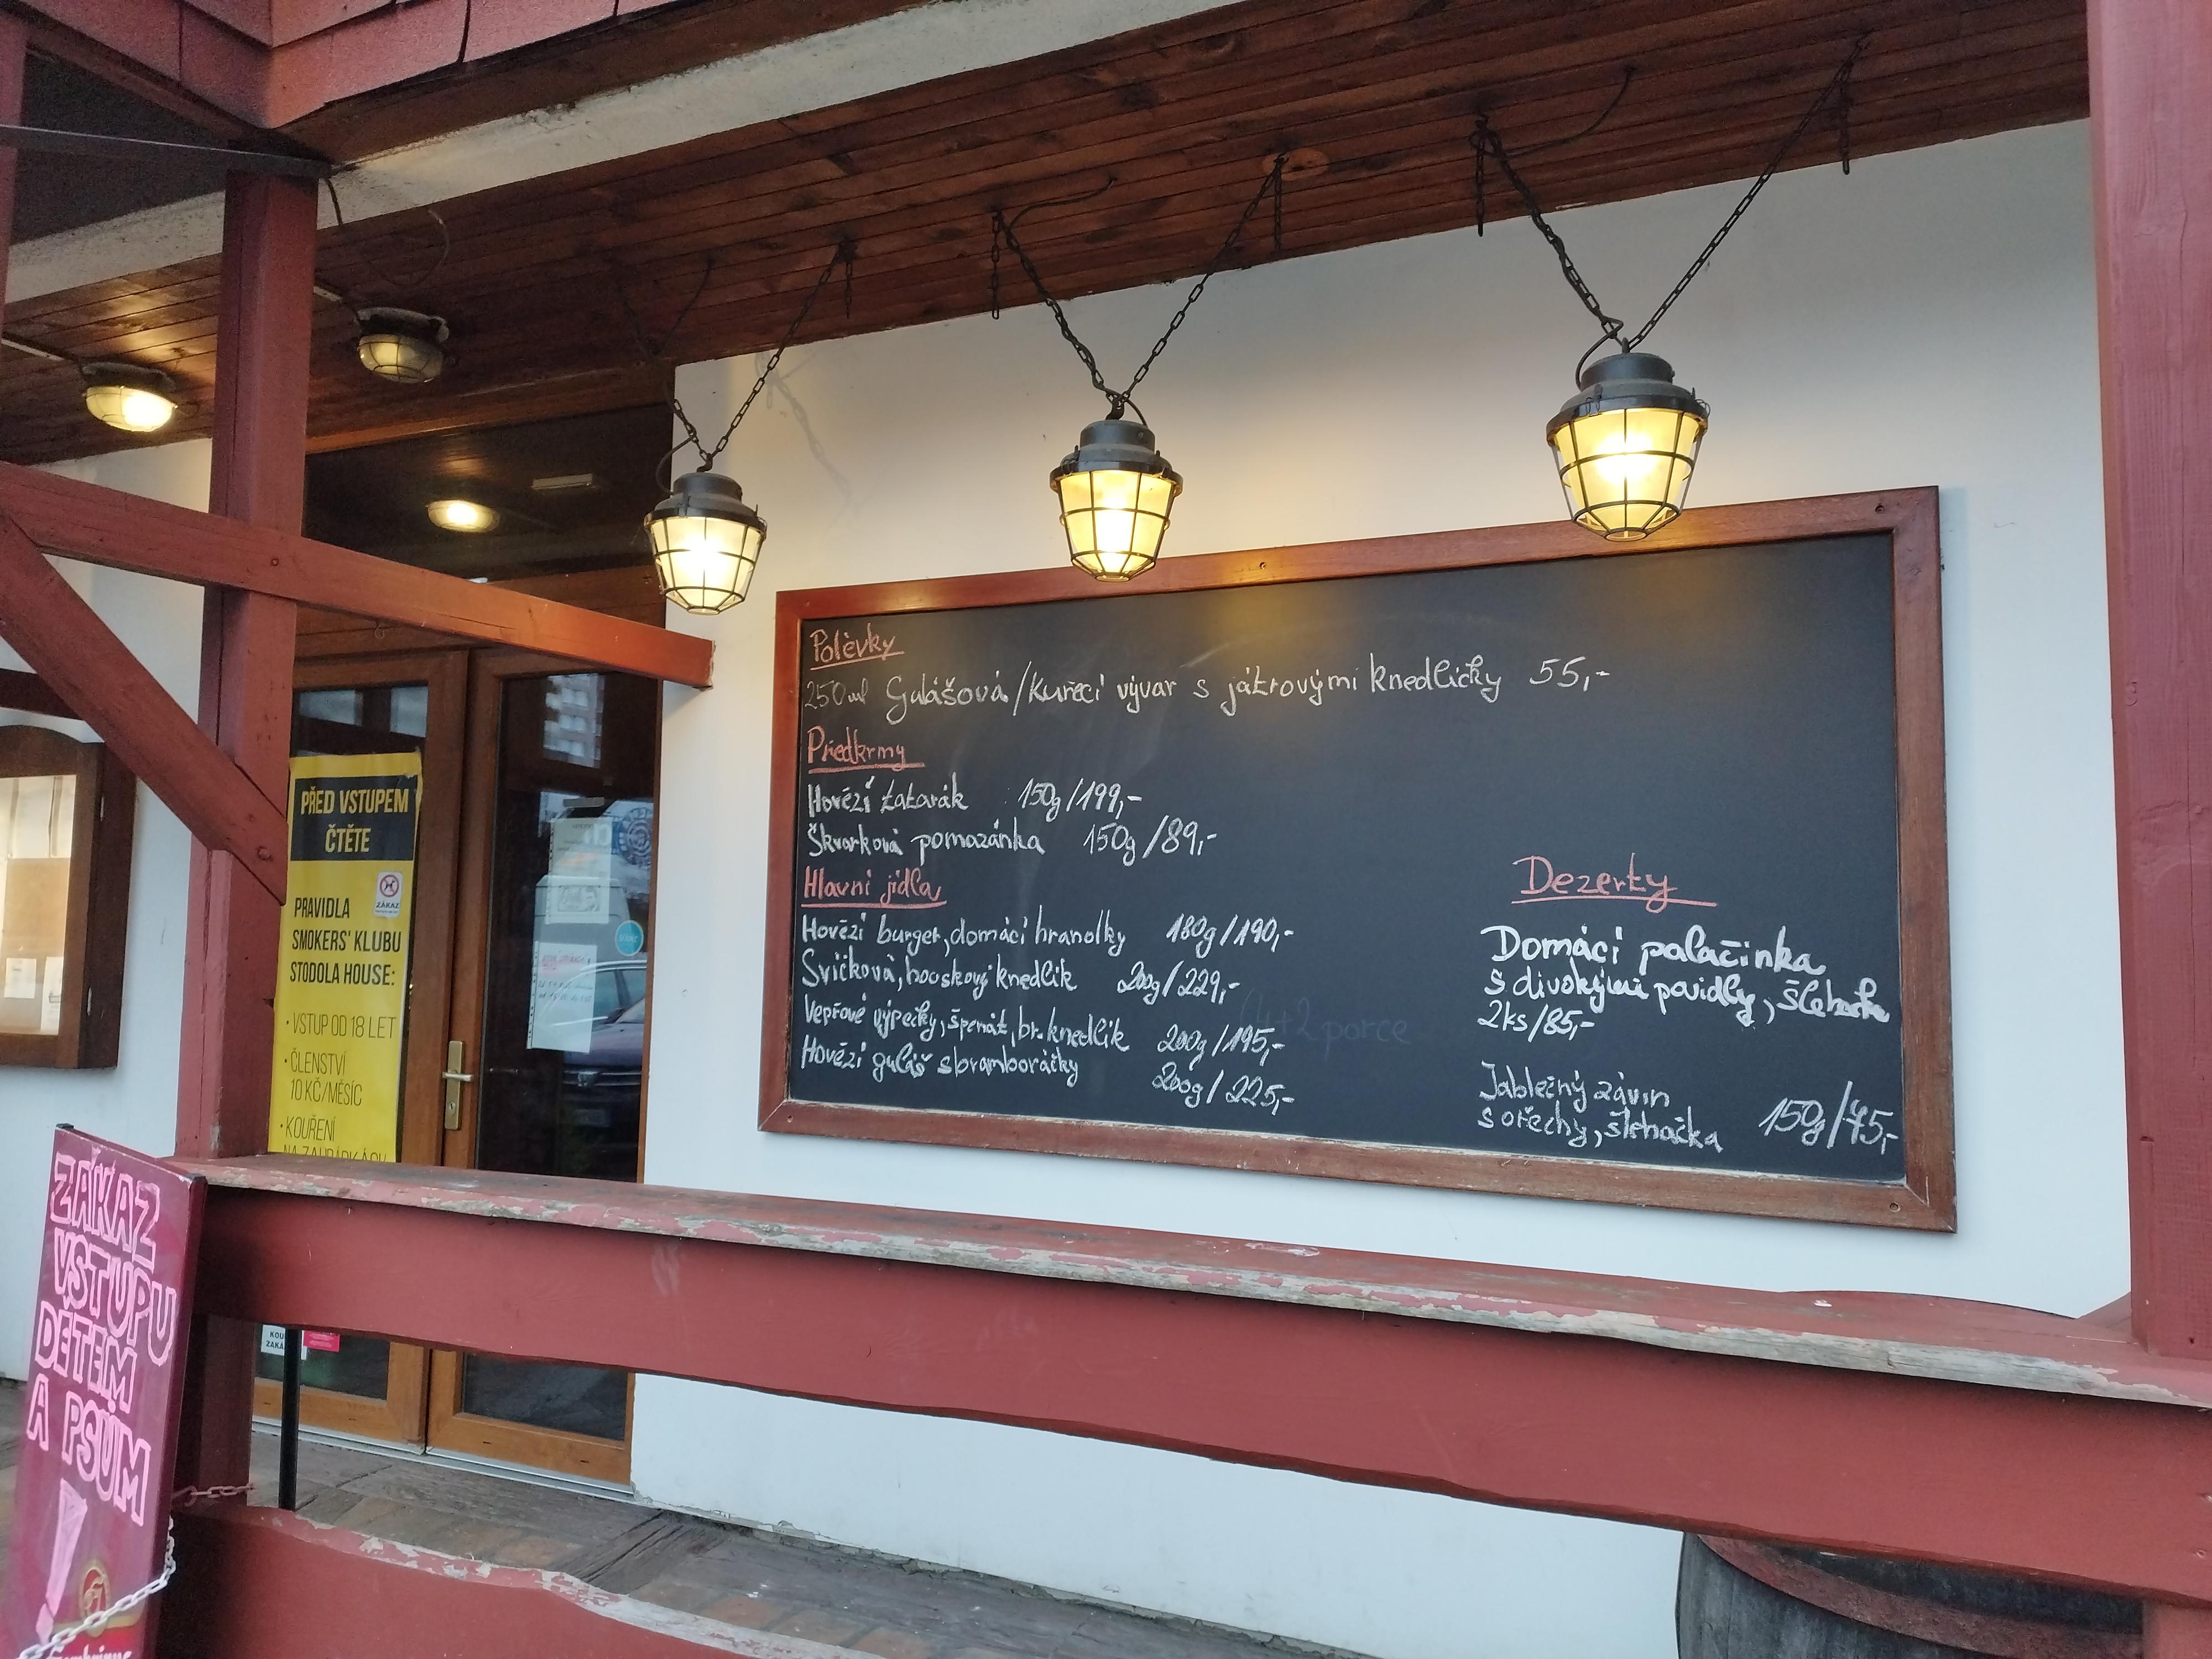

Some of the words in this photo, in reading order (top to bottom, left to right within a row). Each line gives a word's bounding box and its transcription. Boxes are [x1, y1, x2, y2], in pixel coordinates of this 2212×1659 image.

[1117, 675, 1177, 713] vývar
[1193, 678, 1210, 698] s
[300, 786, 335, 815] PŘED
[339, 788, 409, 815] VSTUPEM
[325, 823, 372, 853] ČTĚTE
[910, 816, 1046, 866] pomazánka
[1512, 852, 1679, 914] Dezerty
[294, 897, 350, 919] PRAVIDLA
[292, 929, 351, 952] SMOKERS'
[354, 930, 401, 952] KLUBU
[1480, 924, 1624, 965] Domácí
[1640, 924, 1827, 977] palačinka
[290, 962, 340, 984] STODOLA
[343, 963, 395, 986] HOUSE:
[293, 1013, 328, 1036] VSTUP
[331, 1014, 347, 1037] OD
[351, 1015, 365, 1039] 18
[368, 1016, 397, 1039] LET
[1321, 1018, 1413, 1062] porce
[291, 1047, 347, 1076] ČLENSTVÍ
[291, 1078, 302, 1100] 10
[305, 1077, 363, 1107] KČ/MĚSÍC
[286, 1114, 336, 1142] KOUŘENÍ
[54, 1227, 178, 1366] VSTUPU
[26, 1373, 49, 1451] A
